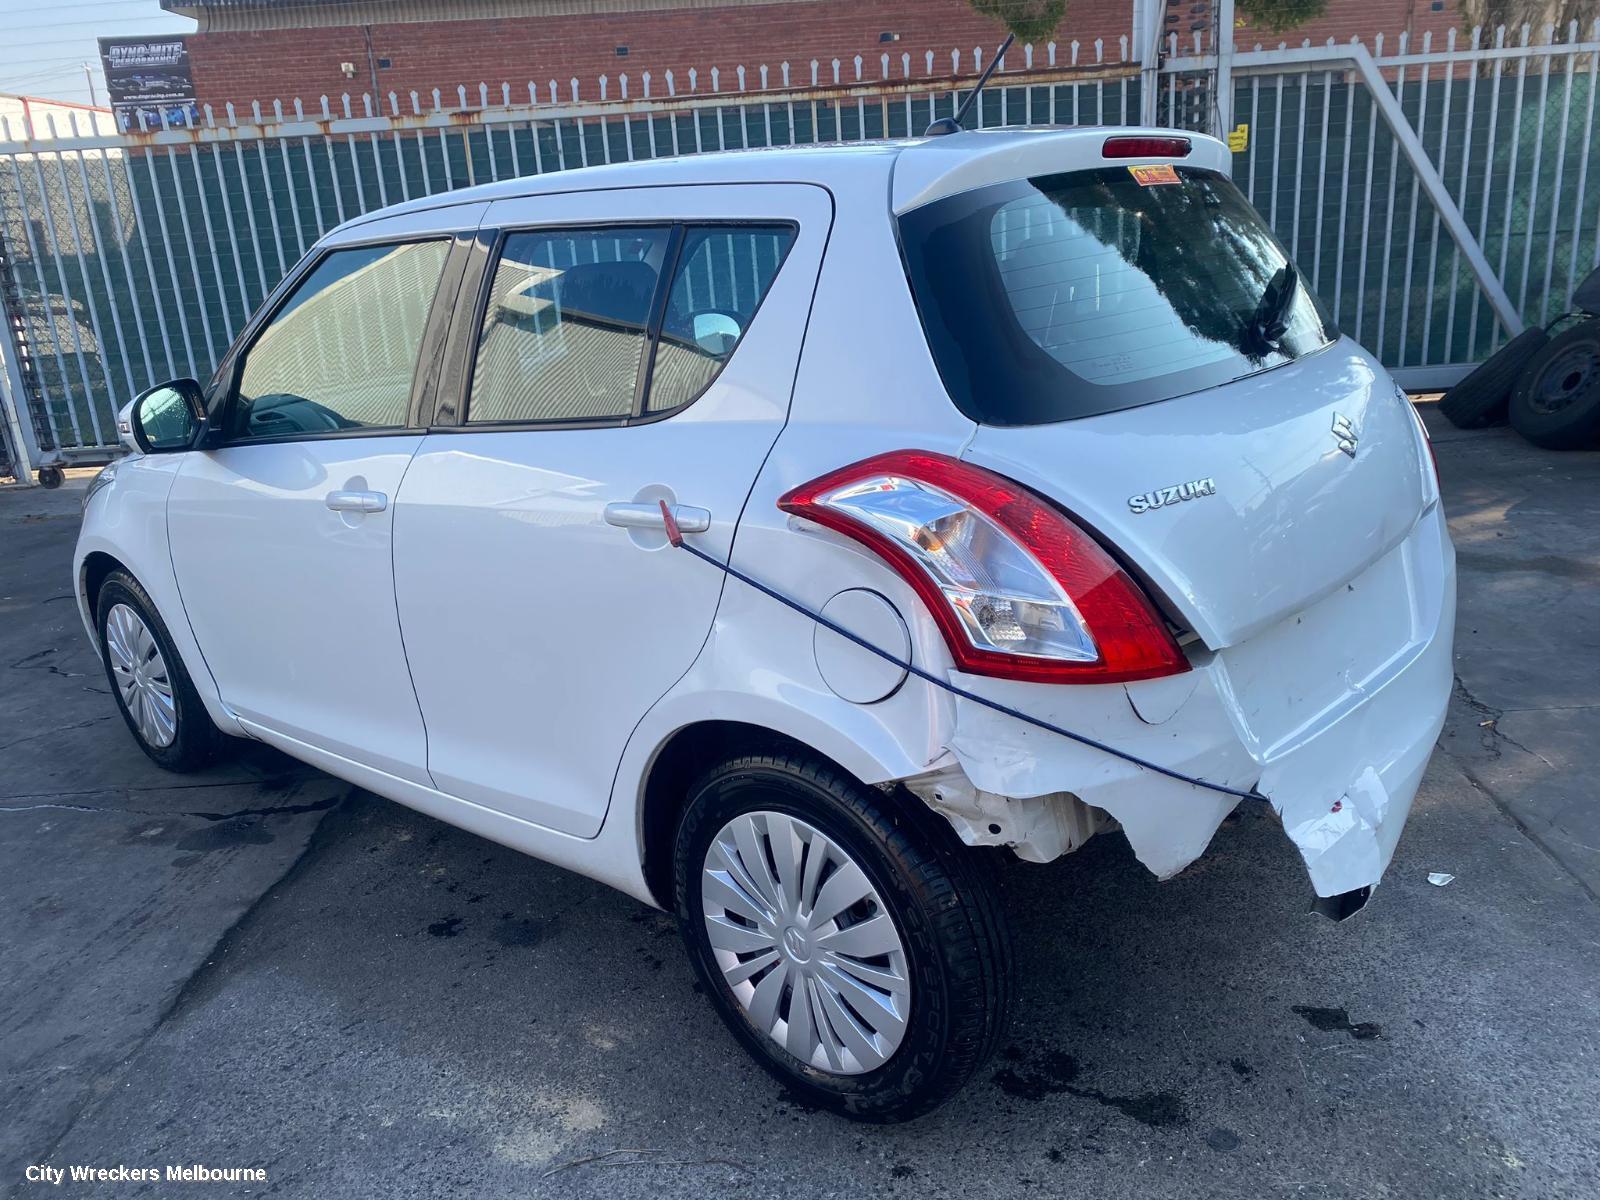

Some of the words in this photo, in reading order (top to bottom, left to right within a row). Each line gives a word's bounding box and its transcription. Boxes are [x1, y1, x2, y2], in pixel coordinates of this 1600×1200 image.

[111, 45, 180, 57] DYNO-MITE
[114, 56, 177, 65] PERFORMANCE
[1127, 477, 1216, 514] SUZUKI
